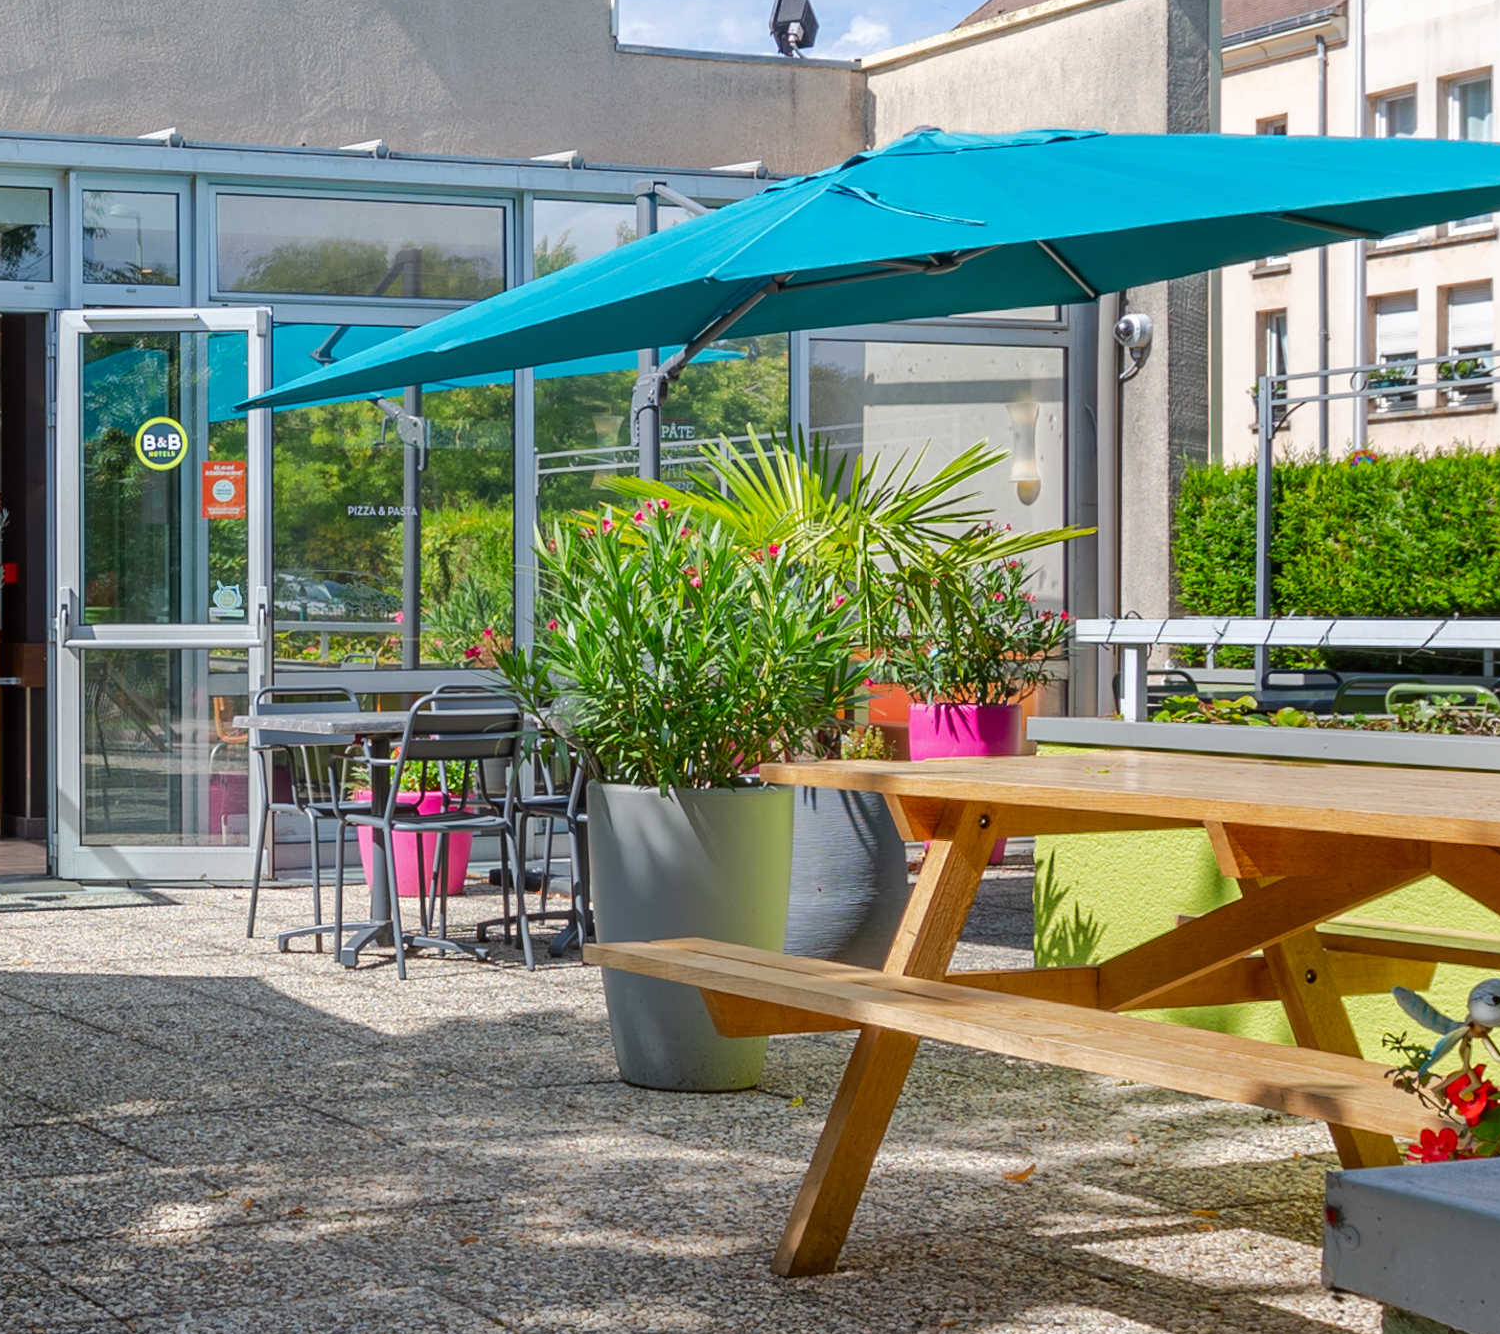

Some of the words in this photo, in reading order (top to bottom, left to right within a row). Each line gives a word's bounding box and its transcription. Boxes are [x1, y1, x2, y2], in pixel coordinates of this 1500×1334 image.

[661, 422, 695, 439] PÂTE
[143, 434, 181, 451] B&B
[149, 450, 176, 458] HOTELS
[347, 505, 376, 516] PIZZA
[378, 505, 385, 516] &
[387, 505, 418, 516] PASTA
